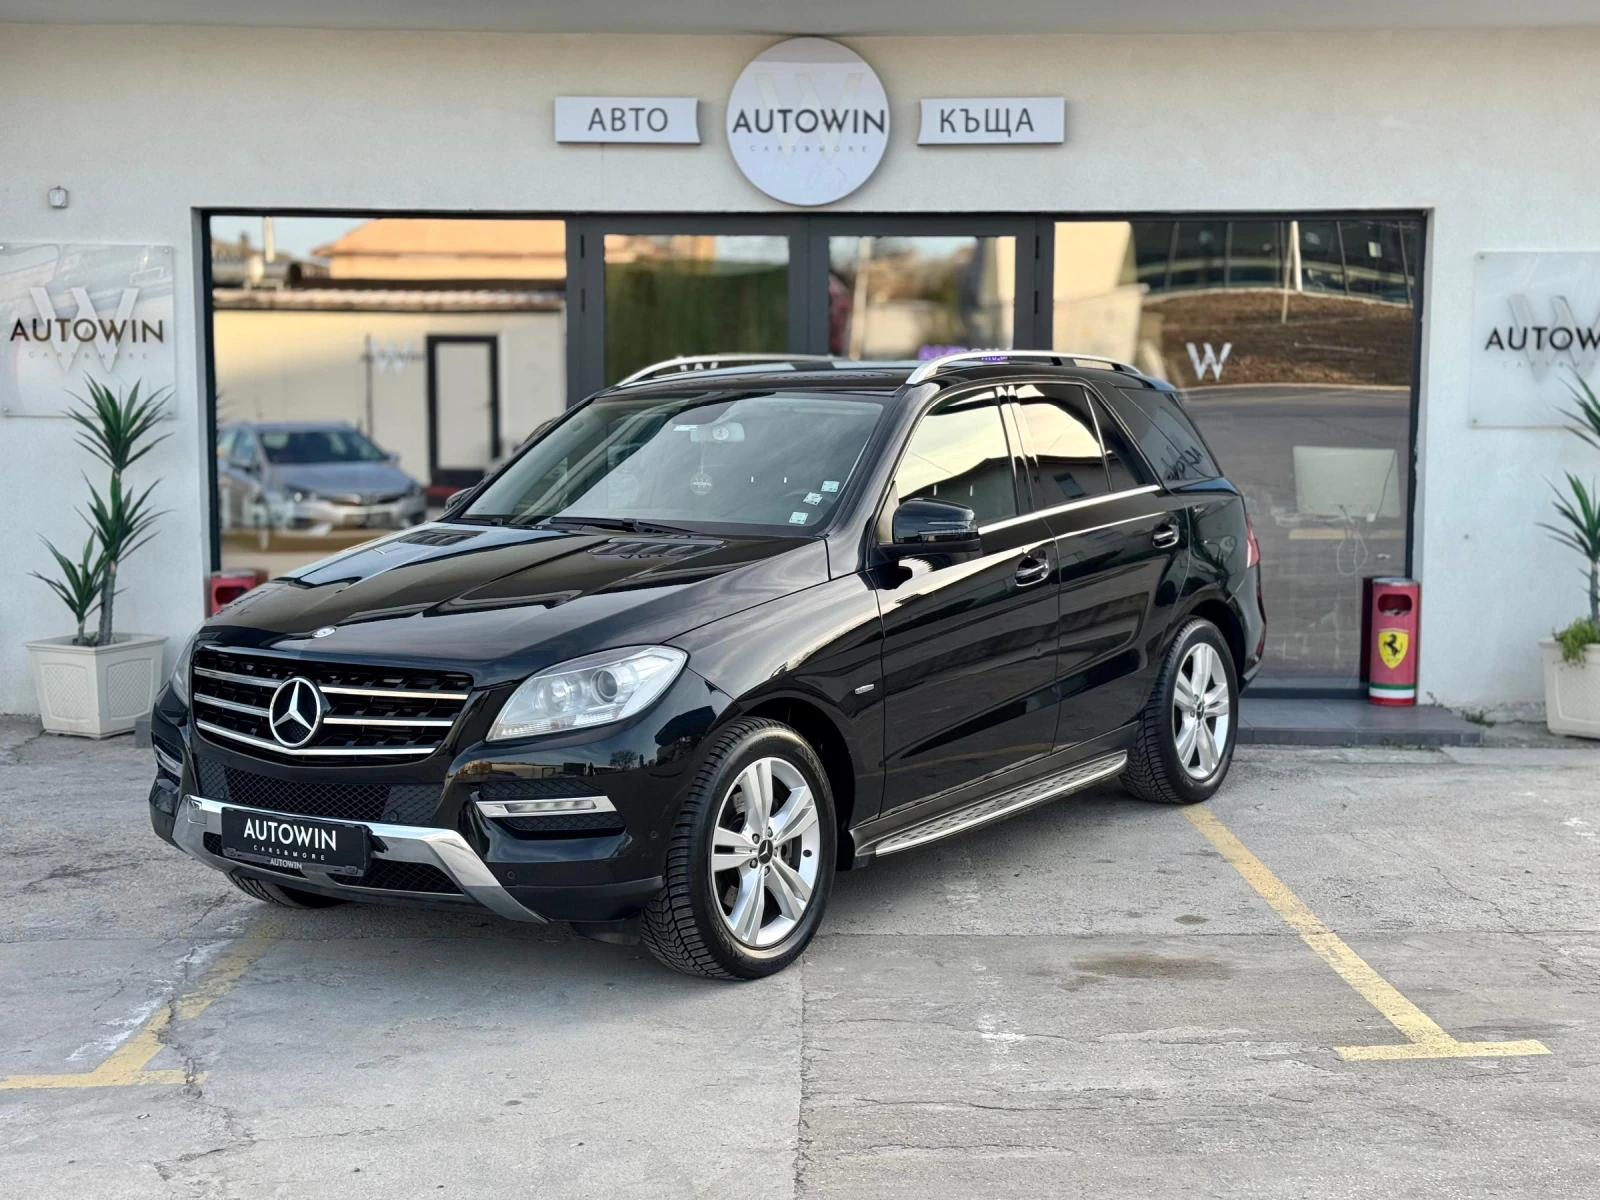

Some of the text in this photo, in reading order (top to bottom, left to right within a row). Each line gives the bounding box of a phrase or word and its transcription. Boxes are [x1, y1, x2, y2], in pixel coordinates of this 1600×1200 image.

[587, 107, 669, 132] АВТО
[732, 108, 885, 134] AUTOWIN
[939, 107, 1034, 138] КЪЩА
[9, 317, 164, 344] AUTOWIN
[1185, 341, 1233, 381] W
[243, 817, 337, 851] AUTOWIN
[253, 844, 325, 861] CARS&MORE
[269, 857, 303, 870] AUTOWIN
